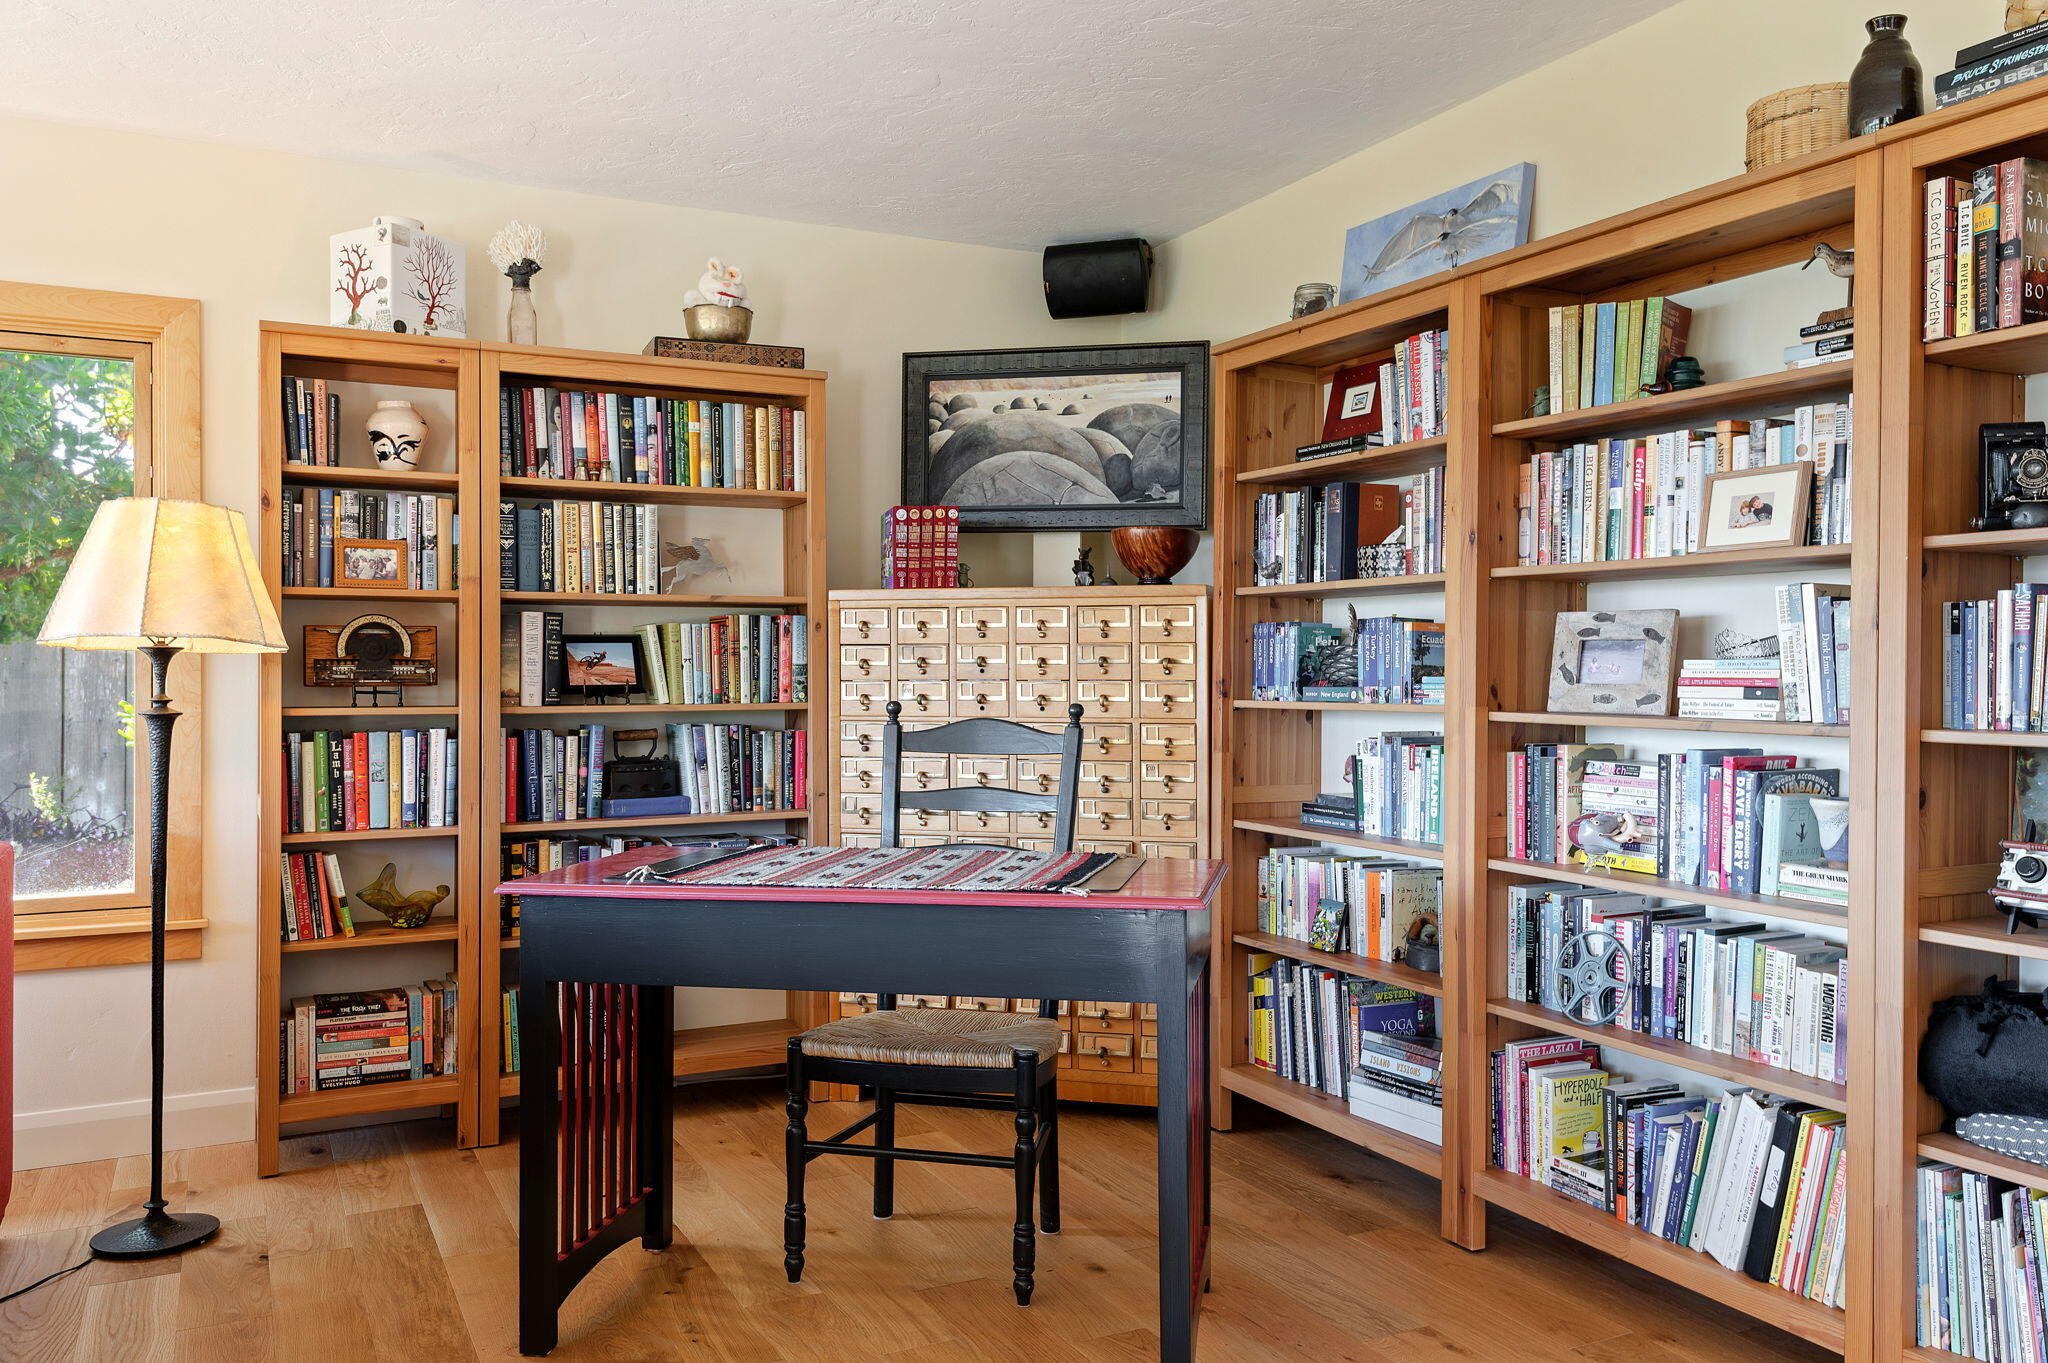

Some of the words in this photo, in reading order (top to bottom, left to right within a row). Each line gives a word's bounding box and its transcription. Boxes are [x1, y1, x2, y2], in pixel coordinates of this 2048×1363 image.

[1951, 63, 1990, 86] BRUCE
[1942, 79, 2000, 103] LEAD
[1930, 214, 1941, 250] BOYLE
[1960, 224, 1969, 248] BOYLE
[1979, 254, 1987, 279] INNER
[1929, 277, 1941, 326] WOMEN
[1979, 287, 1987, 312] CIRCLE
[2004, 287, 2012, 320] BOYLE
[1414, 362, 1422, 406] BRYSON
[1634, 459, 1645, 494] Gulp.
[1585, 480, 1593, 512] BURN
[2014, 593, 2031, 631] SACHAR
[1315, 635, 1339, 646] Peru
[1821, 633, 1830, 654] Dark
[331, 741, 342, 778] Lamb
[1735, 776, 1745, 815] DAVE
[1734, 820, 1745, 870] BARRY
[1744, 860, 1749, 870] TO
[1375, 990, 1416, 1000] WESTERN
[1381, 1019, 1414, 1032] YOGA
[1821, 983, 1835, 1043] WORKING
[1627, 1125, 1635, 1193] BHUTAN
[1748, 1166, 1760, 1196] ANATOMY
